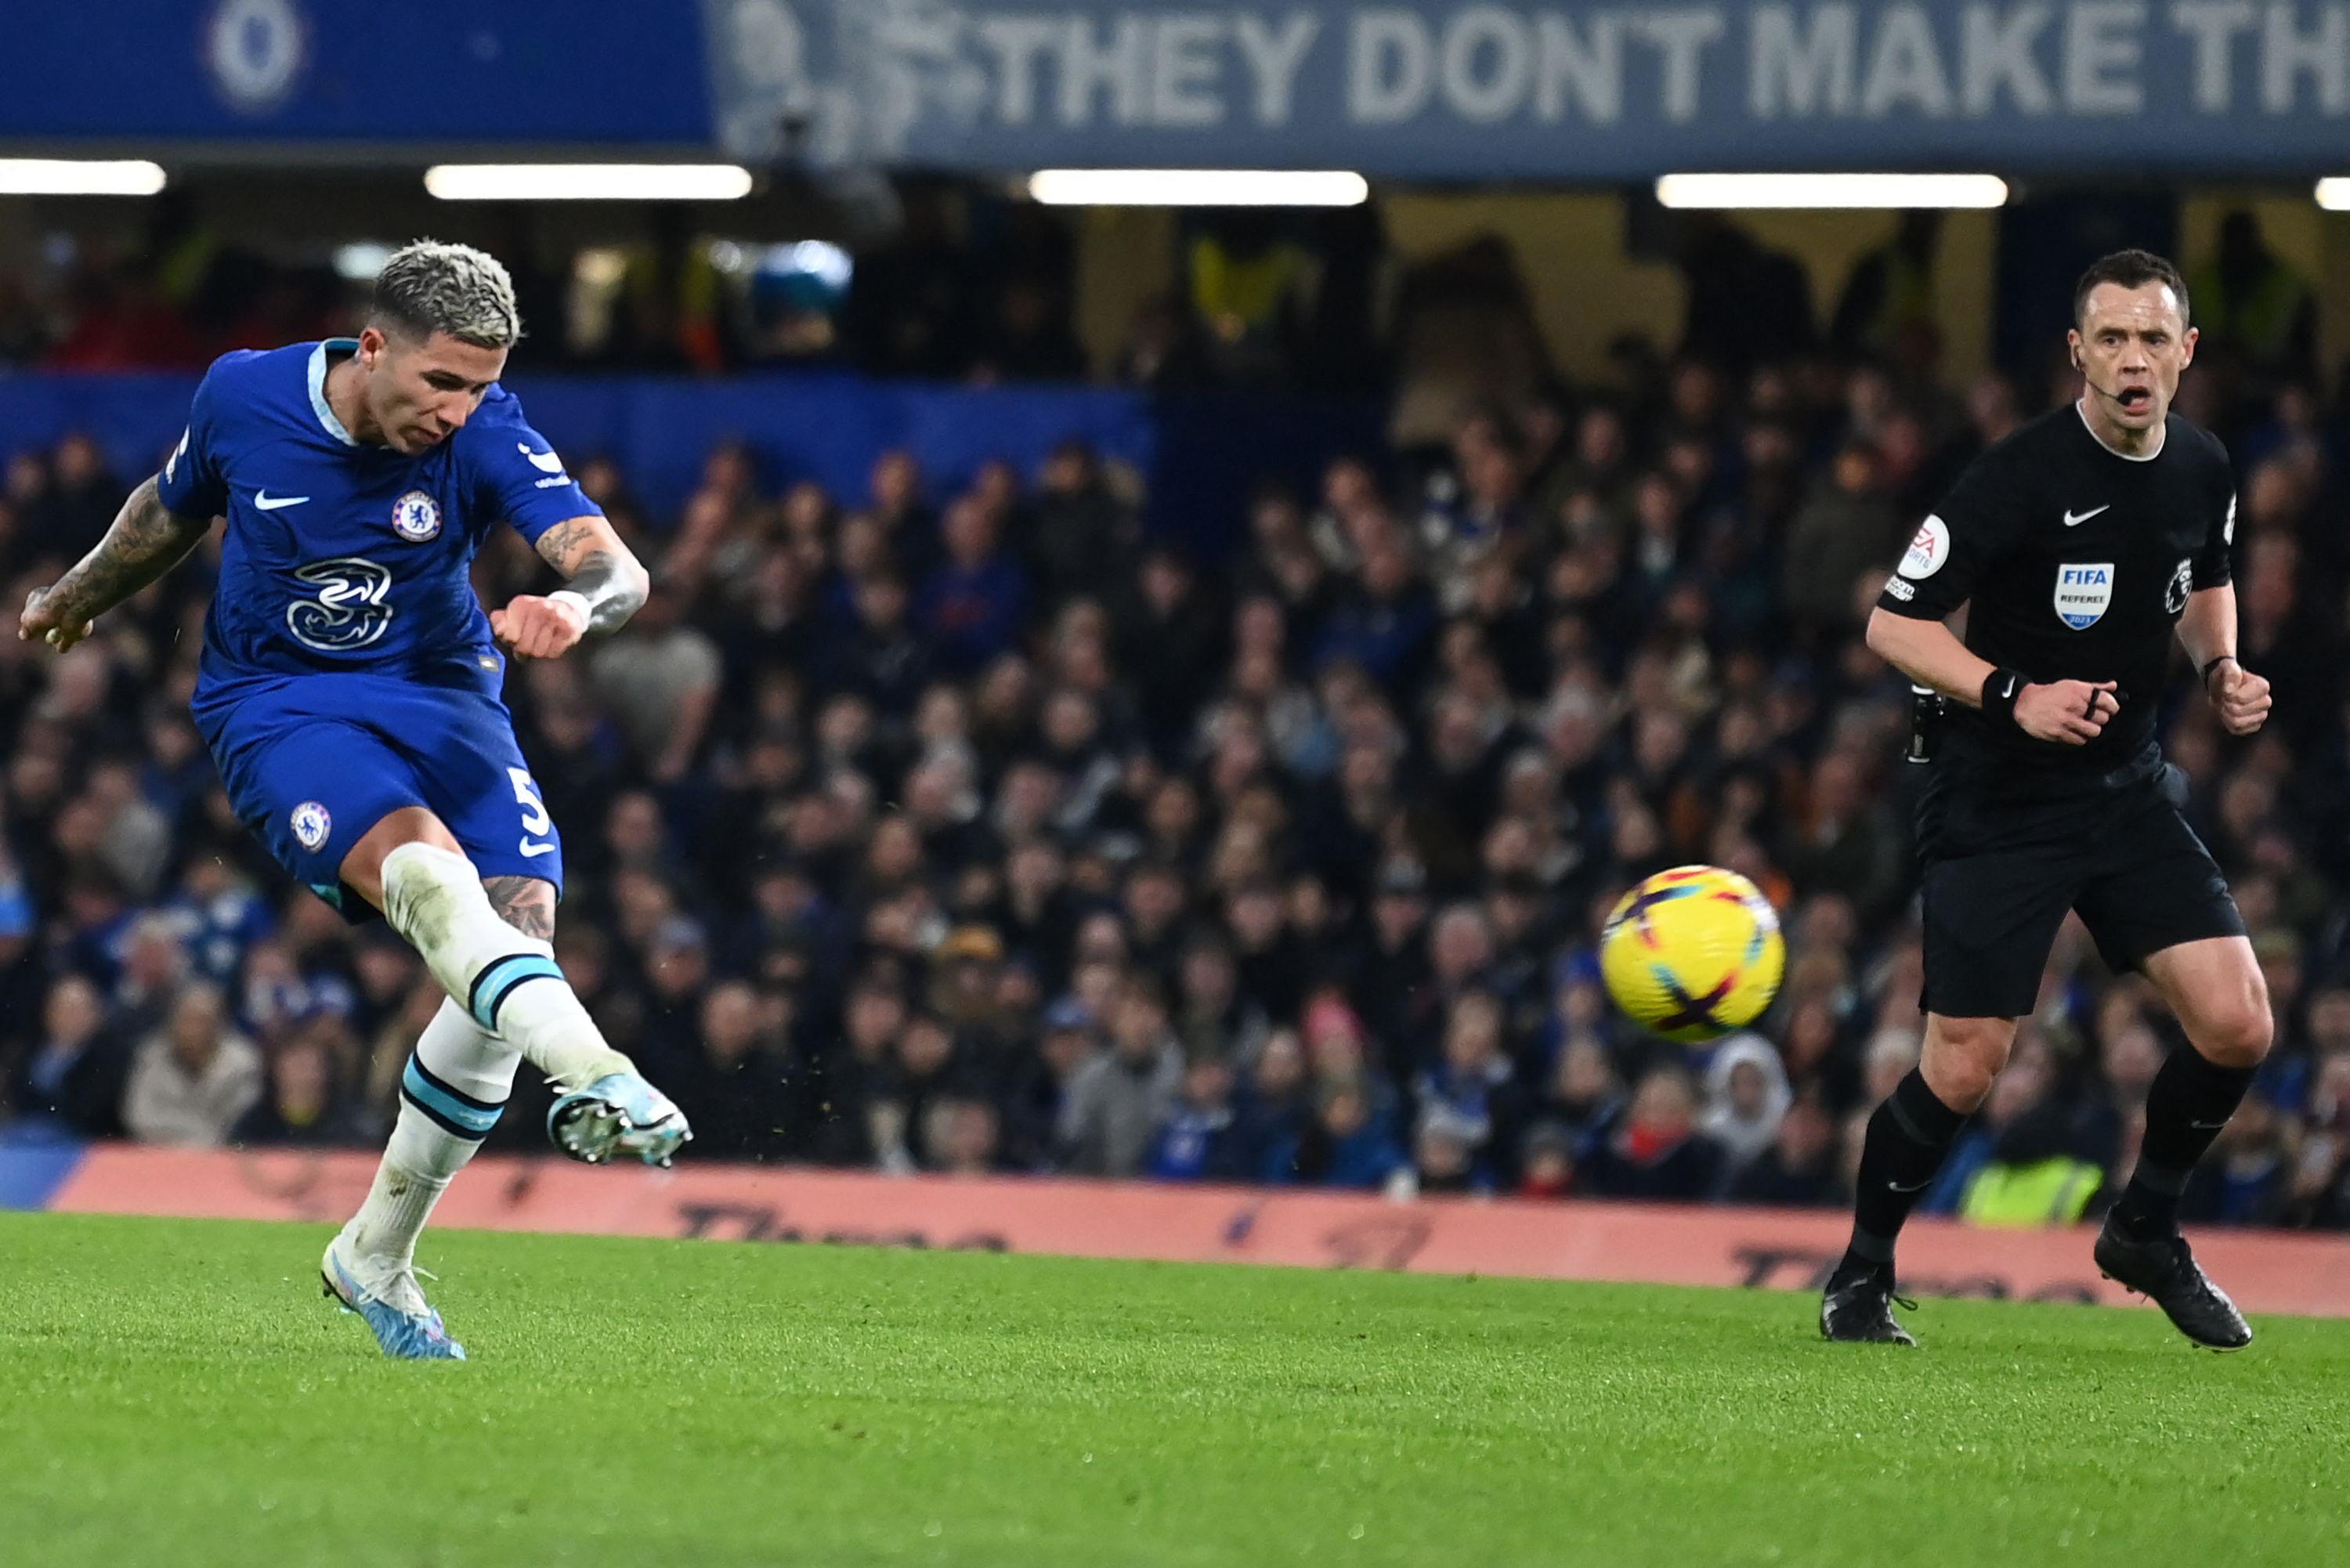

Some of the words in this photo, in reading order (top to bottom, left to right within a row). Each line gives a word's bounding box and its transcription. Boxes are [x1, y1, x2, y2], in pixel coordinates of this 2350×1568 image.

[982, 14, 1324, 125] THEY
[1748, 4, 2145, 117] MAKE
[2063, 569, 2107, 585] FIFA
[2060, 594, 2106, 604] REFEREE
[508, 767, 550, 837] 5
